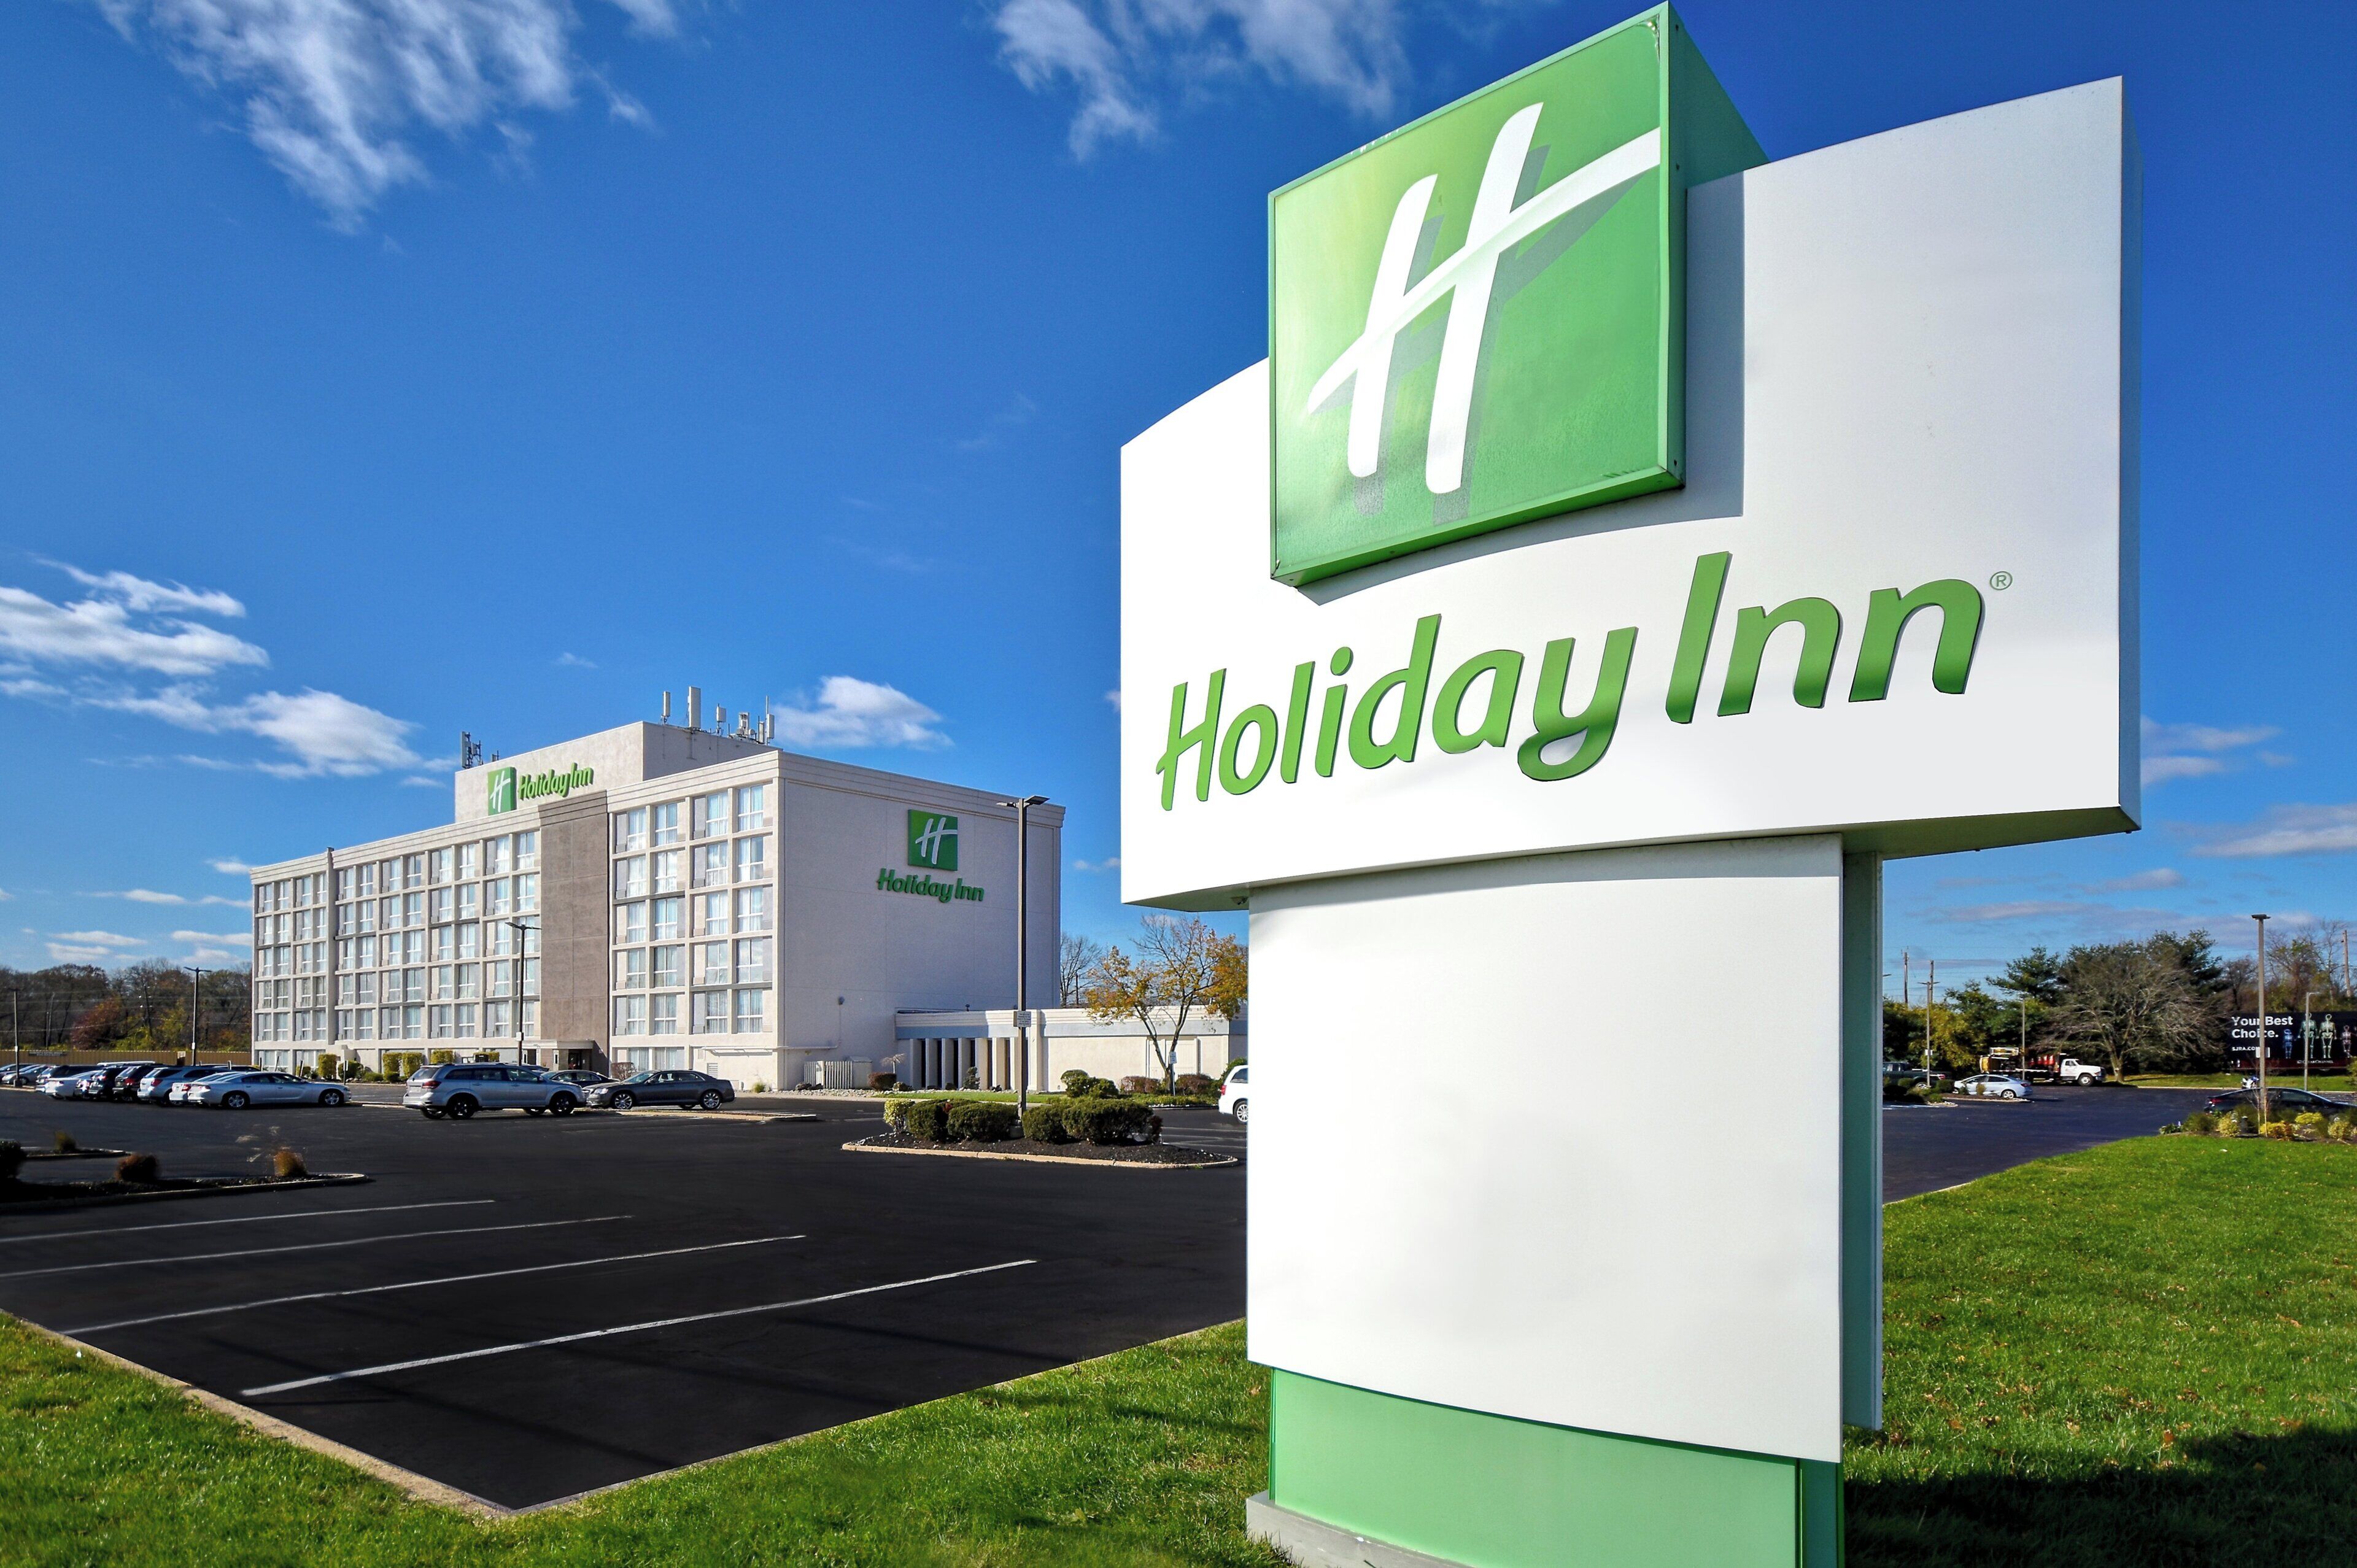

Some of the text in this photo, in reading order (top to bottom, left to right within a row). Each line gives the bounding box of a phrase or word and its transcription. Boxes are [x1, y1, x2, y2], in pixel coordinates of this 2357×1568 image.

[1155, 614, 1638, 812] Holiday
[1665, 550, 1985, 725] Inn
[517, 762, 594, 801] Holiday Inn
[877, 868, 985, 903] Holiday Inn
[2265, 1016, 2293, 1025] Best
